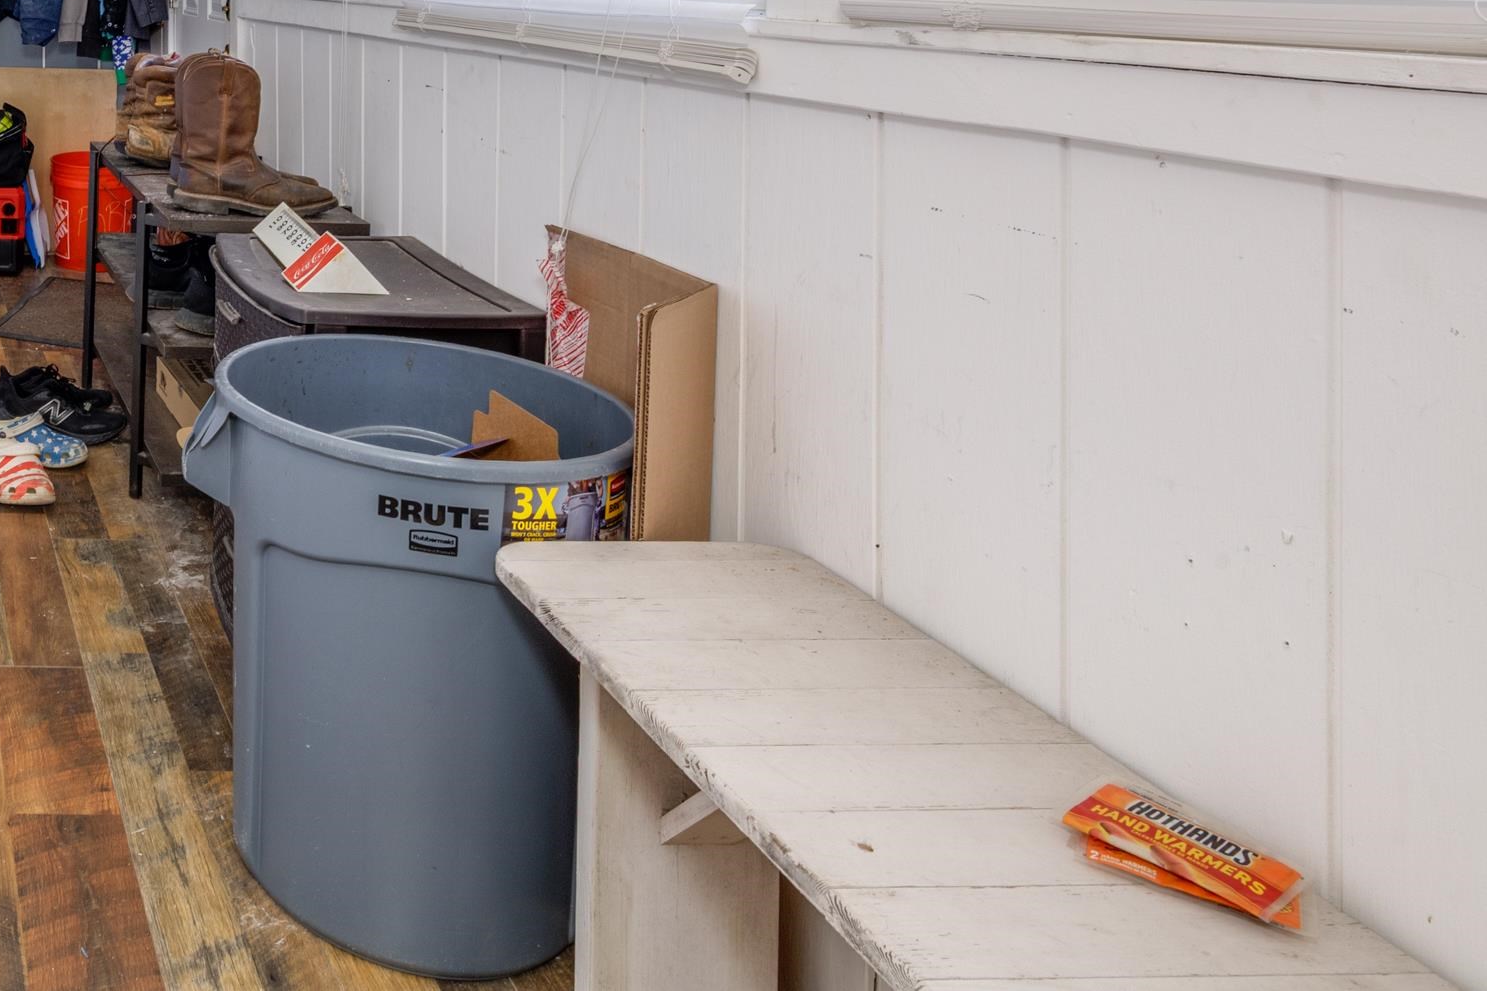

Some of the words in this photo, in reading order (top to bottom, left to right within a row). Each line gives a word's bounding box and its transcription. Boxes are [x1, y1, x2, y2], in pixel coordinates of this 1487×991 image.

[378, 494, 489, 531] BRUTE
[512, 486, 559, 520] 3X
[511, 520, 558, 530] TOUGHER
[1091, 804, 1150, 834] HAND
[1154, 831, 1265, 896] WARMERS
[1127, 800, 1258, 866] HOTHANDS
[1090, 850, 1100, 860] 2
